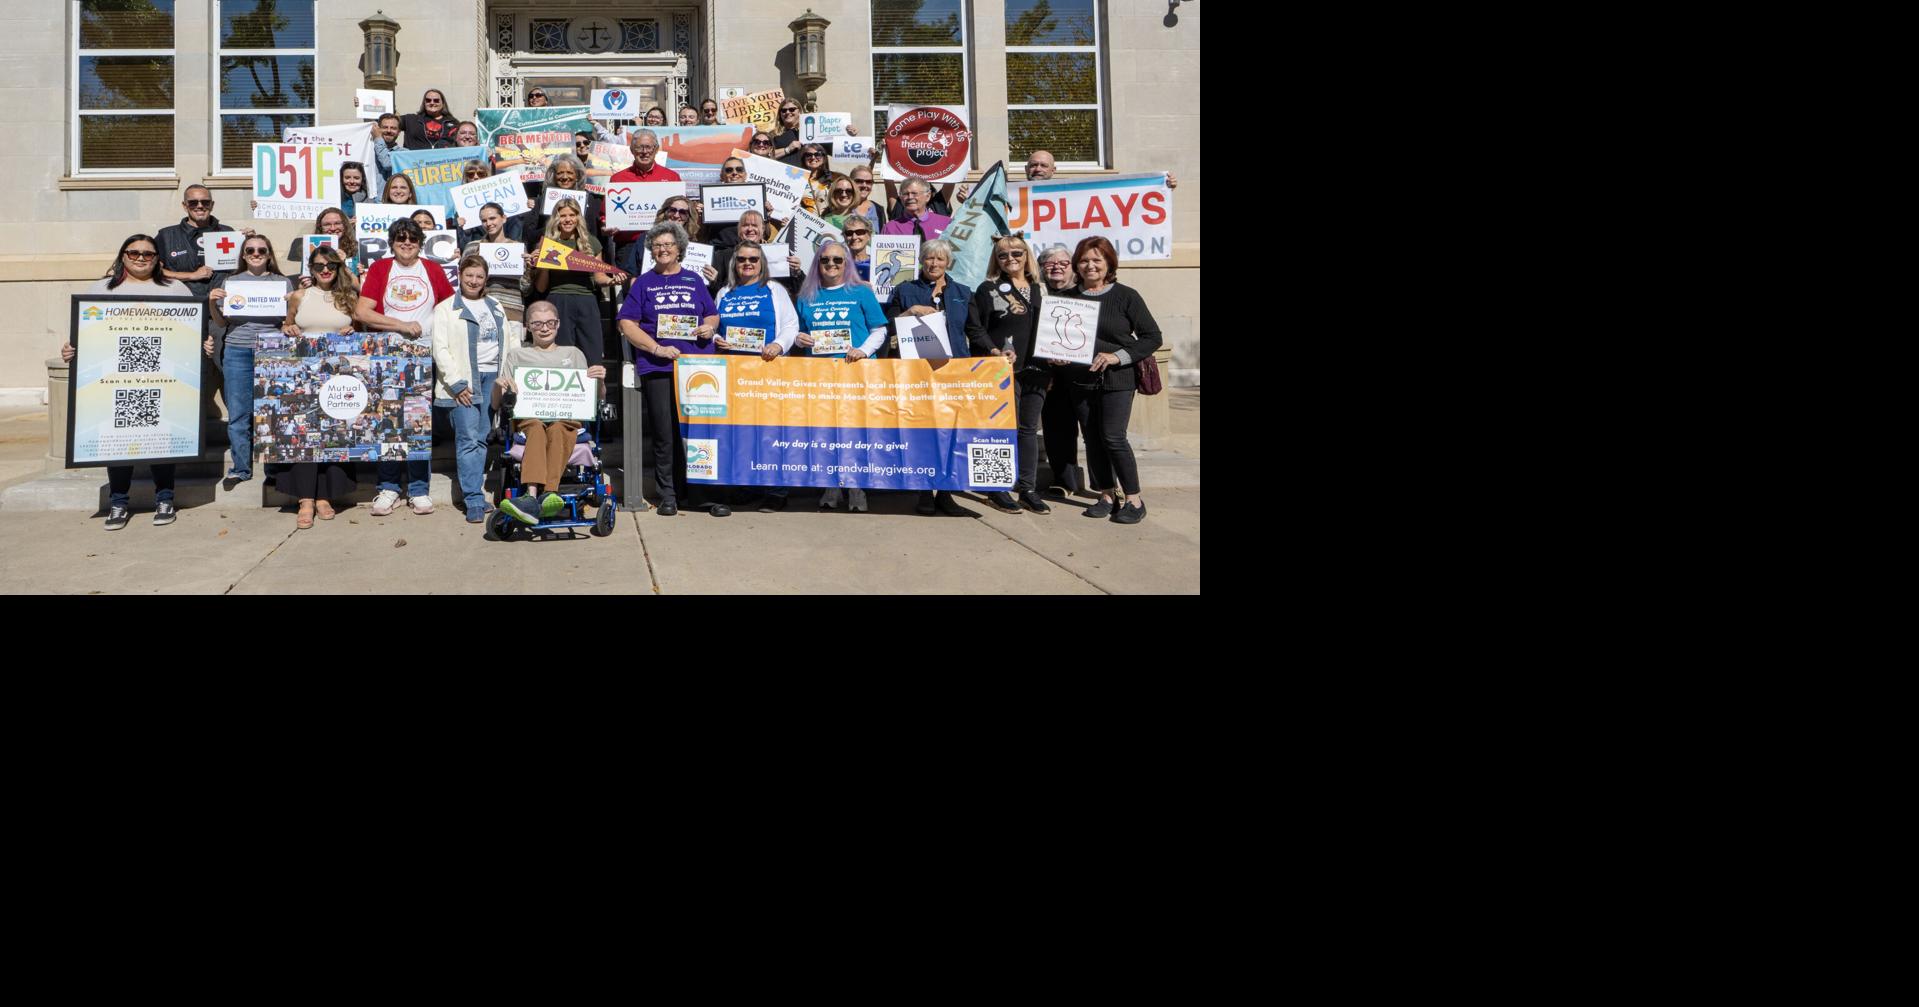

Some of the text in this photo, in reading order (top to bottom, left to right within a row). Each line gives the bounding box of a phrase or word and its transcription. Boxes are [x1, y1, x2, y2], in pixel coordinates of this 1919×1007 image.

[722, 91, 782, 109] LOVE YOUR
[819, 116, 841, 125] Diaper
[890, 111, 968, 142] Come Play With Us
[819, 125, 841, 134] Depot
[499, 131, 572, 145] BE A MENTOR
[901, 140, 933, 148] theatre
[916, 149, 948, 158] project
[257, 145, 334, 200] D51F
[402, 161, 466, 186] EUREK
[461, 176, 512, 196] Citizens for
[749, 173, 791, 192] sunshine
[464, 185, 516, 209] CLEAN
[711, 196, 757, 208] Hilltop
[628, 203, 657, 211] CASA
[1006, 187, 1167, 231] JPLAYS
[257, 211, 317, 219] FOUNDAT
[361, 214, 397, 222] Weste
[796, 207, 825, 228] Preparing
[568, 256, 597, 266] COLORADO
[105, 307, 199, 317] HOMEWARDBOUND
[524, 369, 586, 392] CDA
[737, 378, 993, 391] Grand Valley Gives represents local nonprofit organizations
[328, 392, 342, 400] Aid
[735, 392, 767, 401] working
[769, 392, 805, 401] together
[868, 393, 898, 402] County
[938, 394, 963, 402] place
[327, 400, 360, 408] Partners
[772, 440, 790, 449] Any
[792, 440, 808, 450] day
[811, 440, 818, 448] is
[829, 441, 852, 451] good
[855, 441, 872, 451] day
[886, 442, 908, 451] give!
[751, 461, 936, 477] Learn more at: grandvalleygives.org
